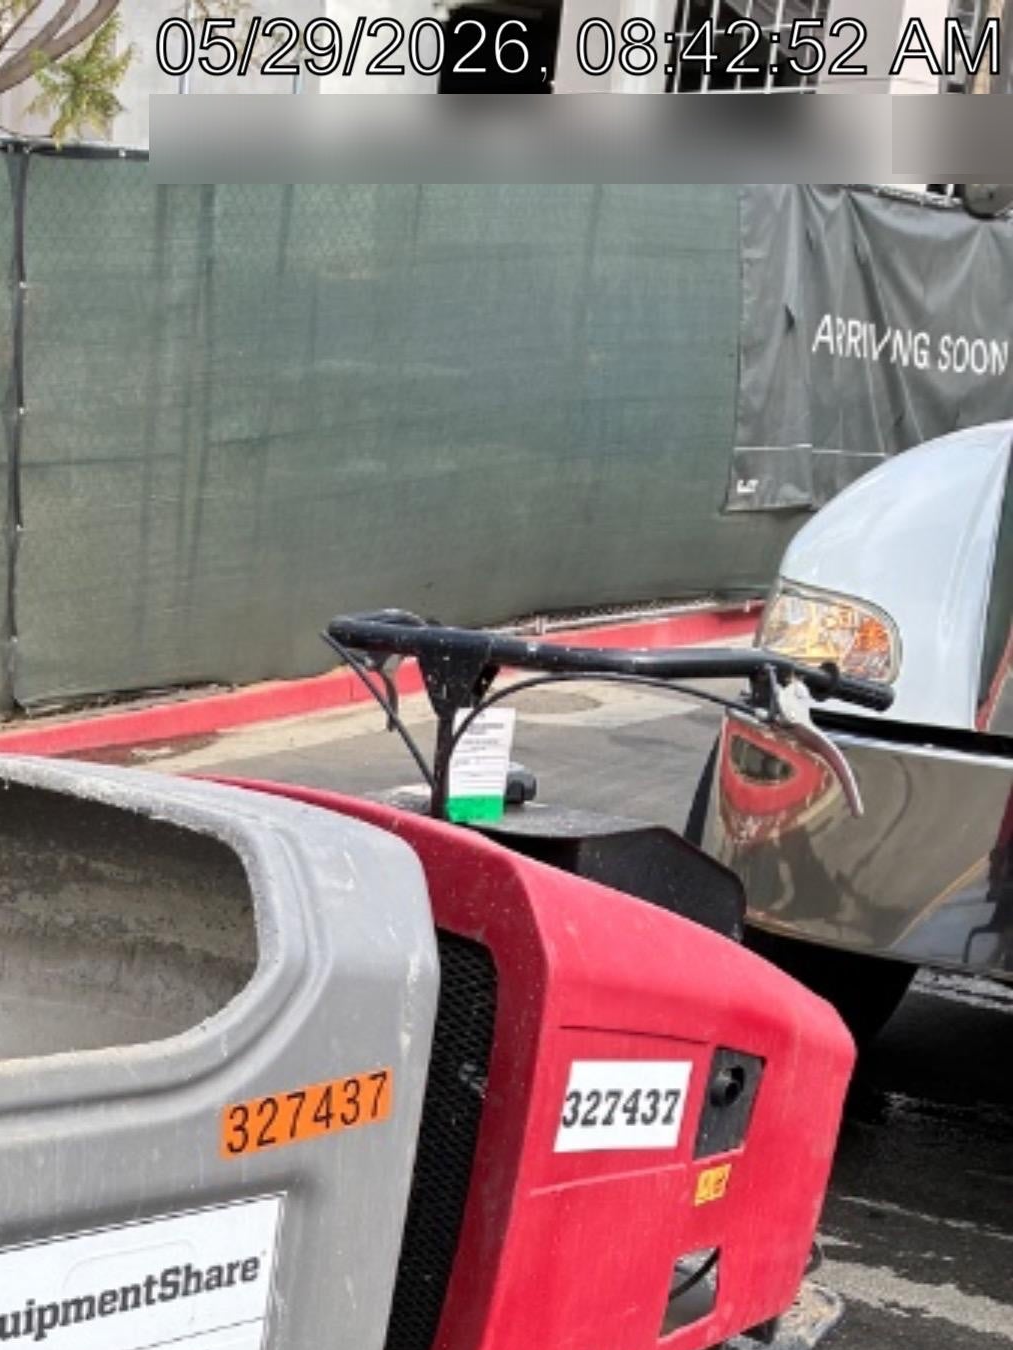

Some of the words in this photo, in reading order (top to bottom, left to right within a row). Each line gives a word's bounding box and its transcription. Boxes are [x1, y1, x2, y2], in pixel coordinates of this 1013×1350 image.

[937, 333, 1009, 376] SOON
[226, 1070, 388, 1154] 327437
[561, 1088, 682, 1129] 327437
